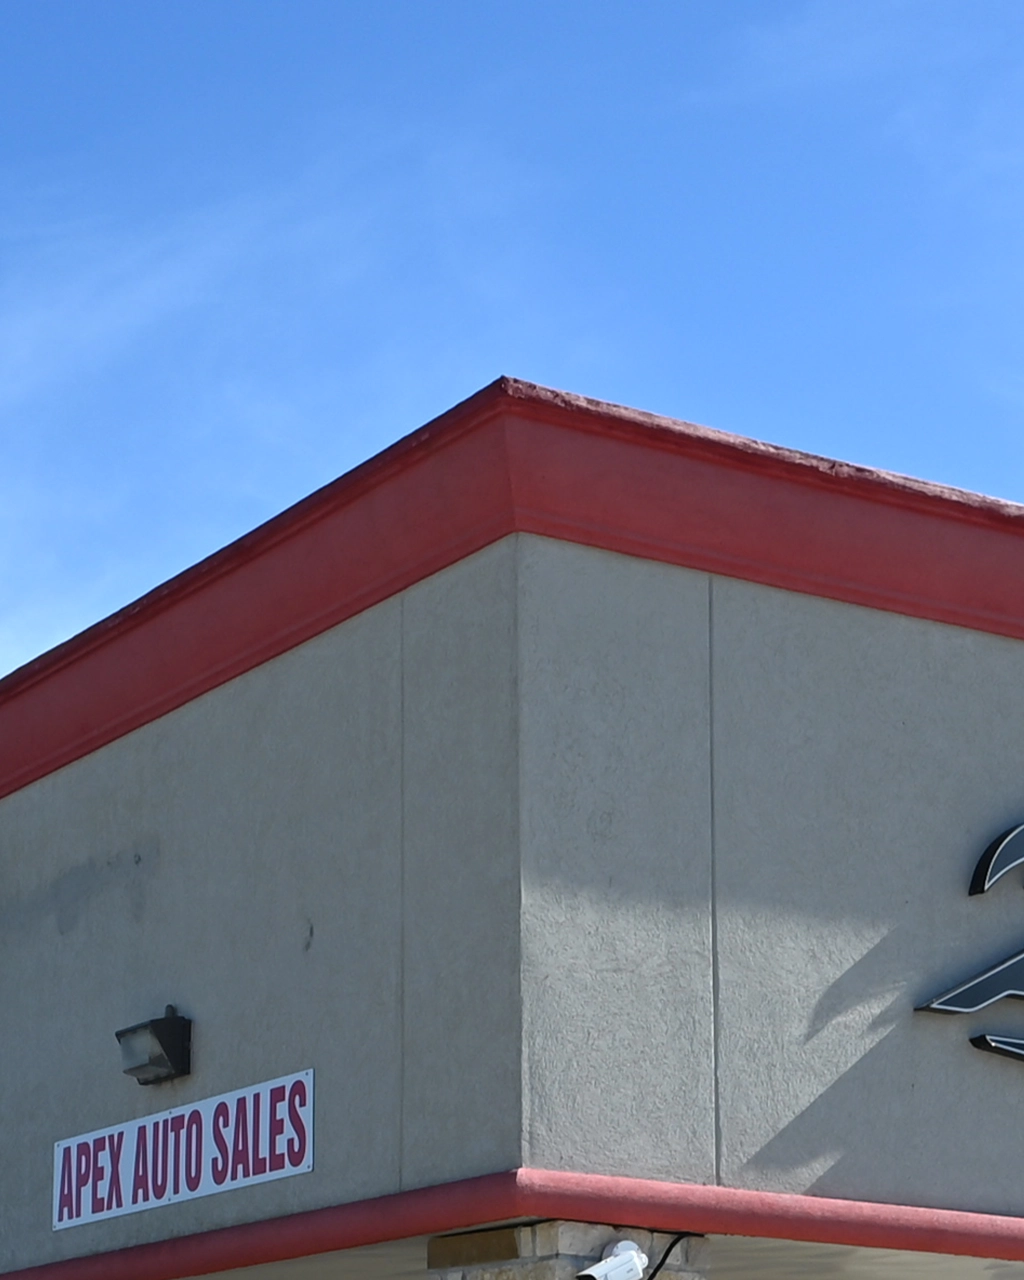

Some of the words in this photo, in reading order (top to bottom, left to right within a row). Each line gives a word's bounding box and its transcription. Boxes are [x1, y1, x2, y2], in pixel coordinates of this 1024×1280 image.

[57, 1131, 125, 1223] APEX
[131, 1109, 203, 1205] AUTO
[211, 1079, 307, 1186] SALES
